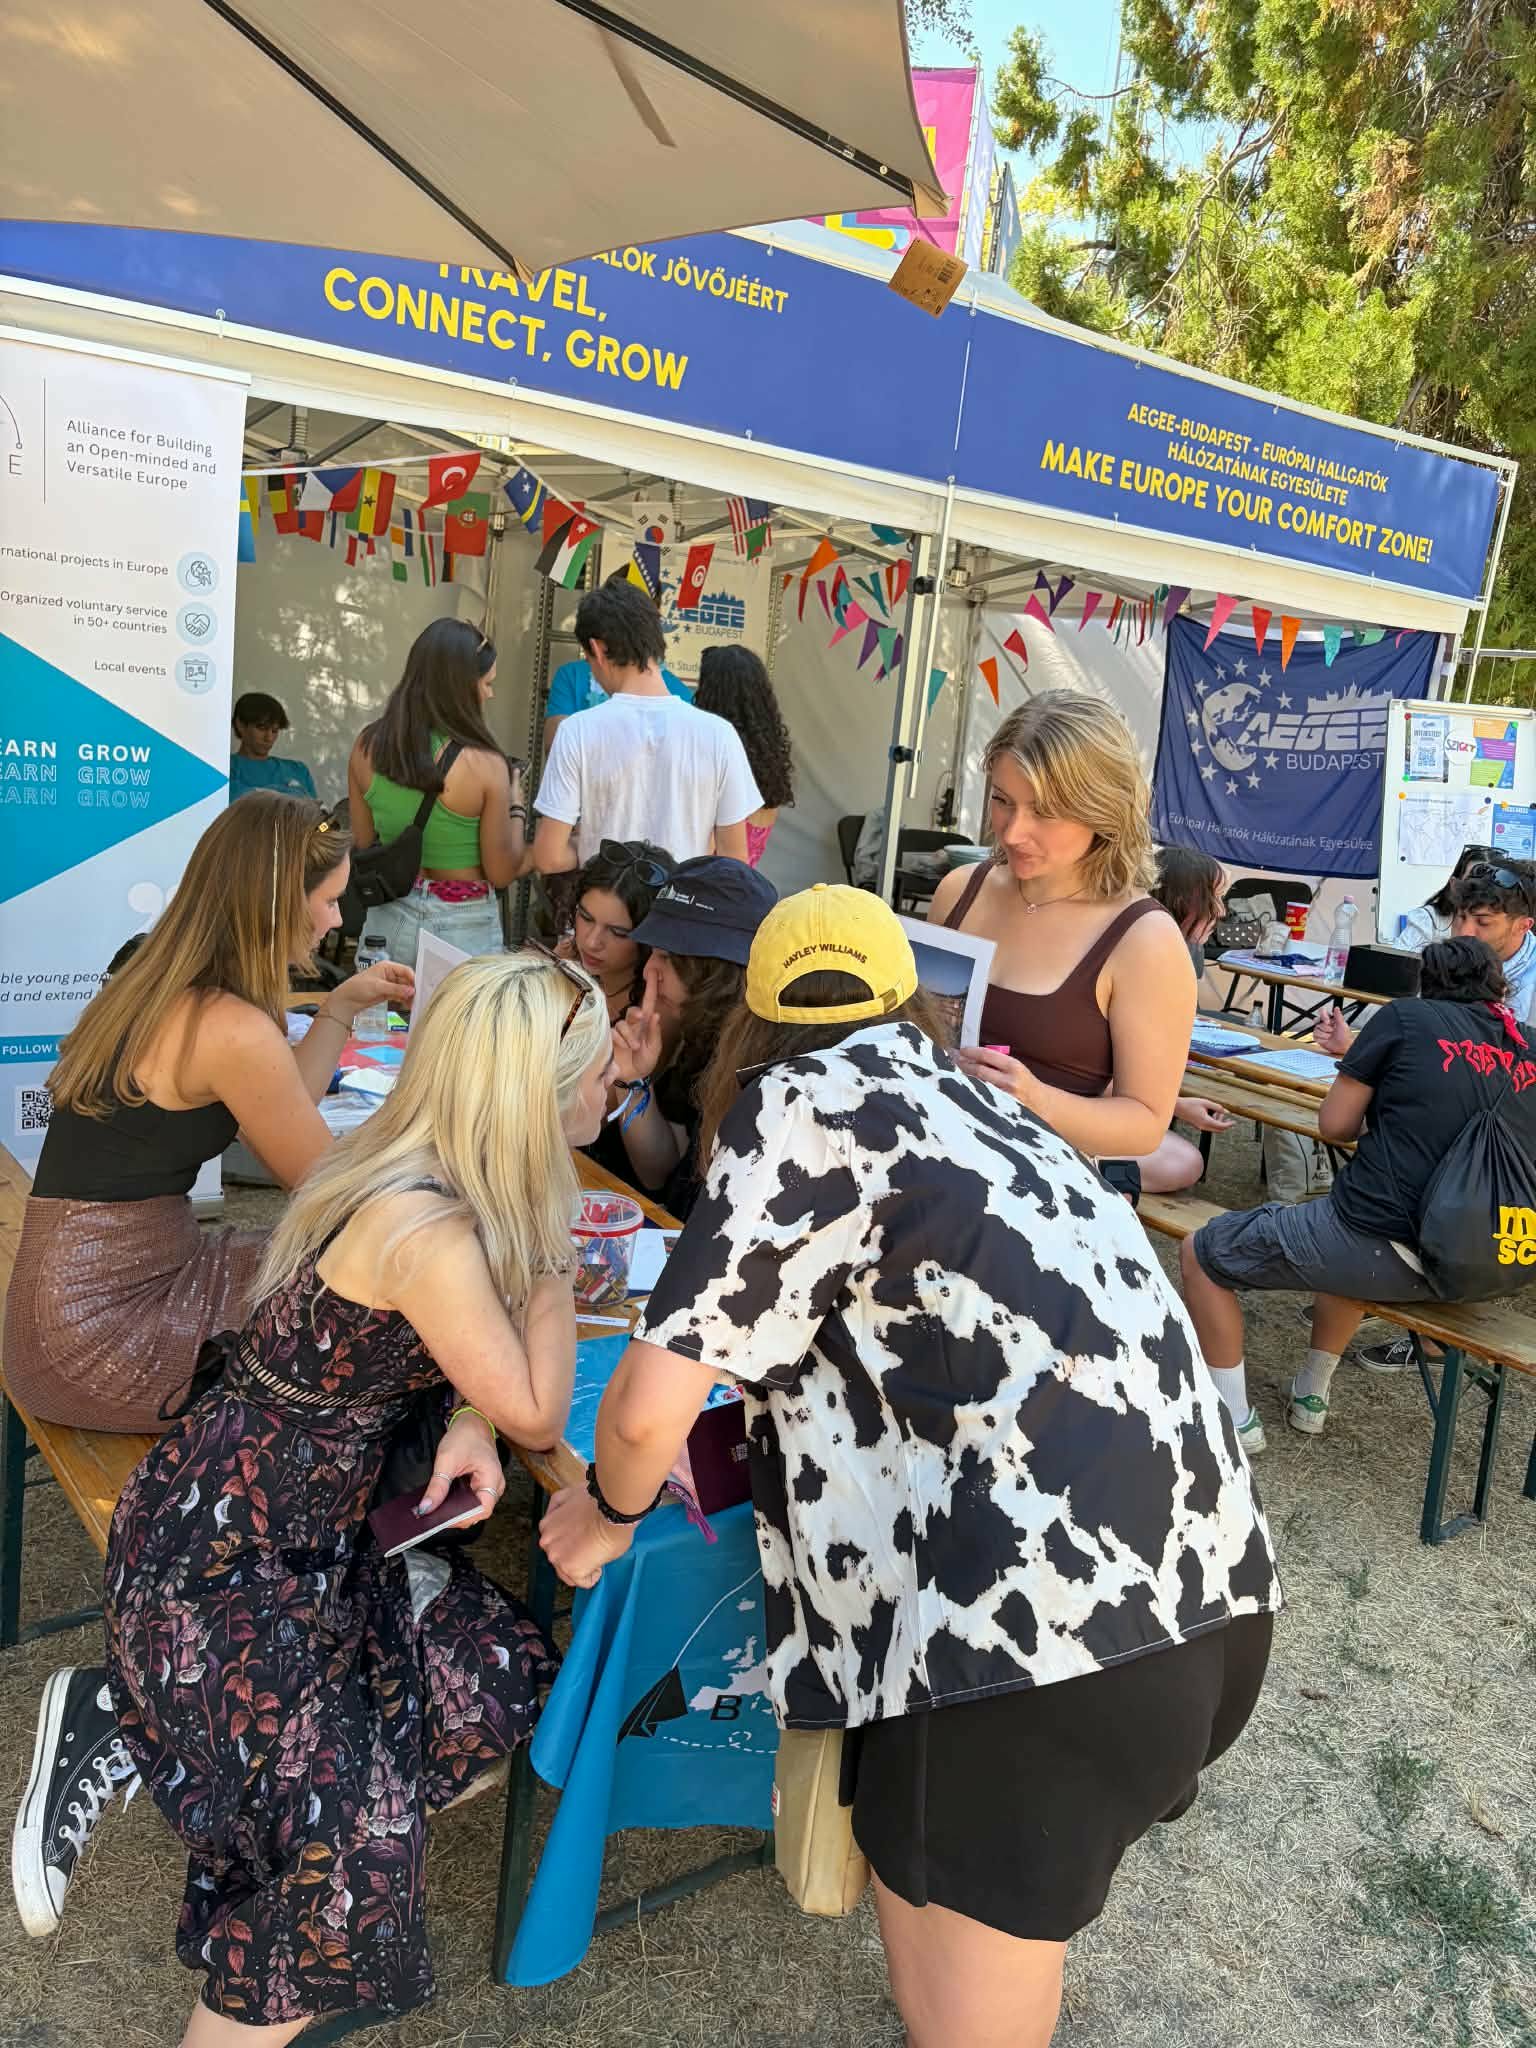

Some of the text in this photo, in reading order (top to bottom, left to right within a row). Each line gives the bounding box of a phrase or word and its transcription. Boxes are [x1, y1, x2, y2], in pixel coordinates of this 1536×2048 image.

[661, 256, 789, 313] JÖVŐJÉÉRT
[324, 267, 688, 390] CONNECT, GROW
[67, 420, 213, 458] Alliance for Building
[1127, 402, 1252, 454] AEGEE-BUDAPEST
[1261, 441, 1316, 473] EURÓPAI
[1316, 458, 1389, 493] HALLGATÓK
[67, 442, 217, 475] an Open-minded and
[67, 459, 188, 490] Versatile Europe
[1168, 441, 1349, 506] HÁLÓZATÁNAK EGYESÜLETE
[1040, 439, 1434, 563] MAKE EUROPE YOUR COMFORT ZONE!
[60, 553, 110, 568] projects
[113, 558, 124, 570] in
[127, 561, 169, 576] Europe
[0, 590, 168, 618] Organized voluntary service
[74, 615, 168, 634] in 50+ countries
[695, 624, 745, 639] BUDAPEST
[94, 659, 167, 676] Local events
[78, 743, 151, 763] GROW
[1286, 752, 1385, 771] BUDAPEST
[77, 765, 151, 786] GROW
[77, 788, 151, 809] GROW
[782, 943, 868, 969] HAYLEY WILLIAMS
[26, 973, 71, 986] young
[13, 989, 42, 1001] and
[45, 988, 93, 1001] extend
[2, 1044, 53, 1055] FOLLOW
[710, 1694, 743, 1721] B
